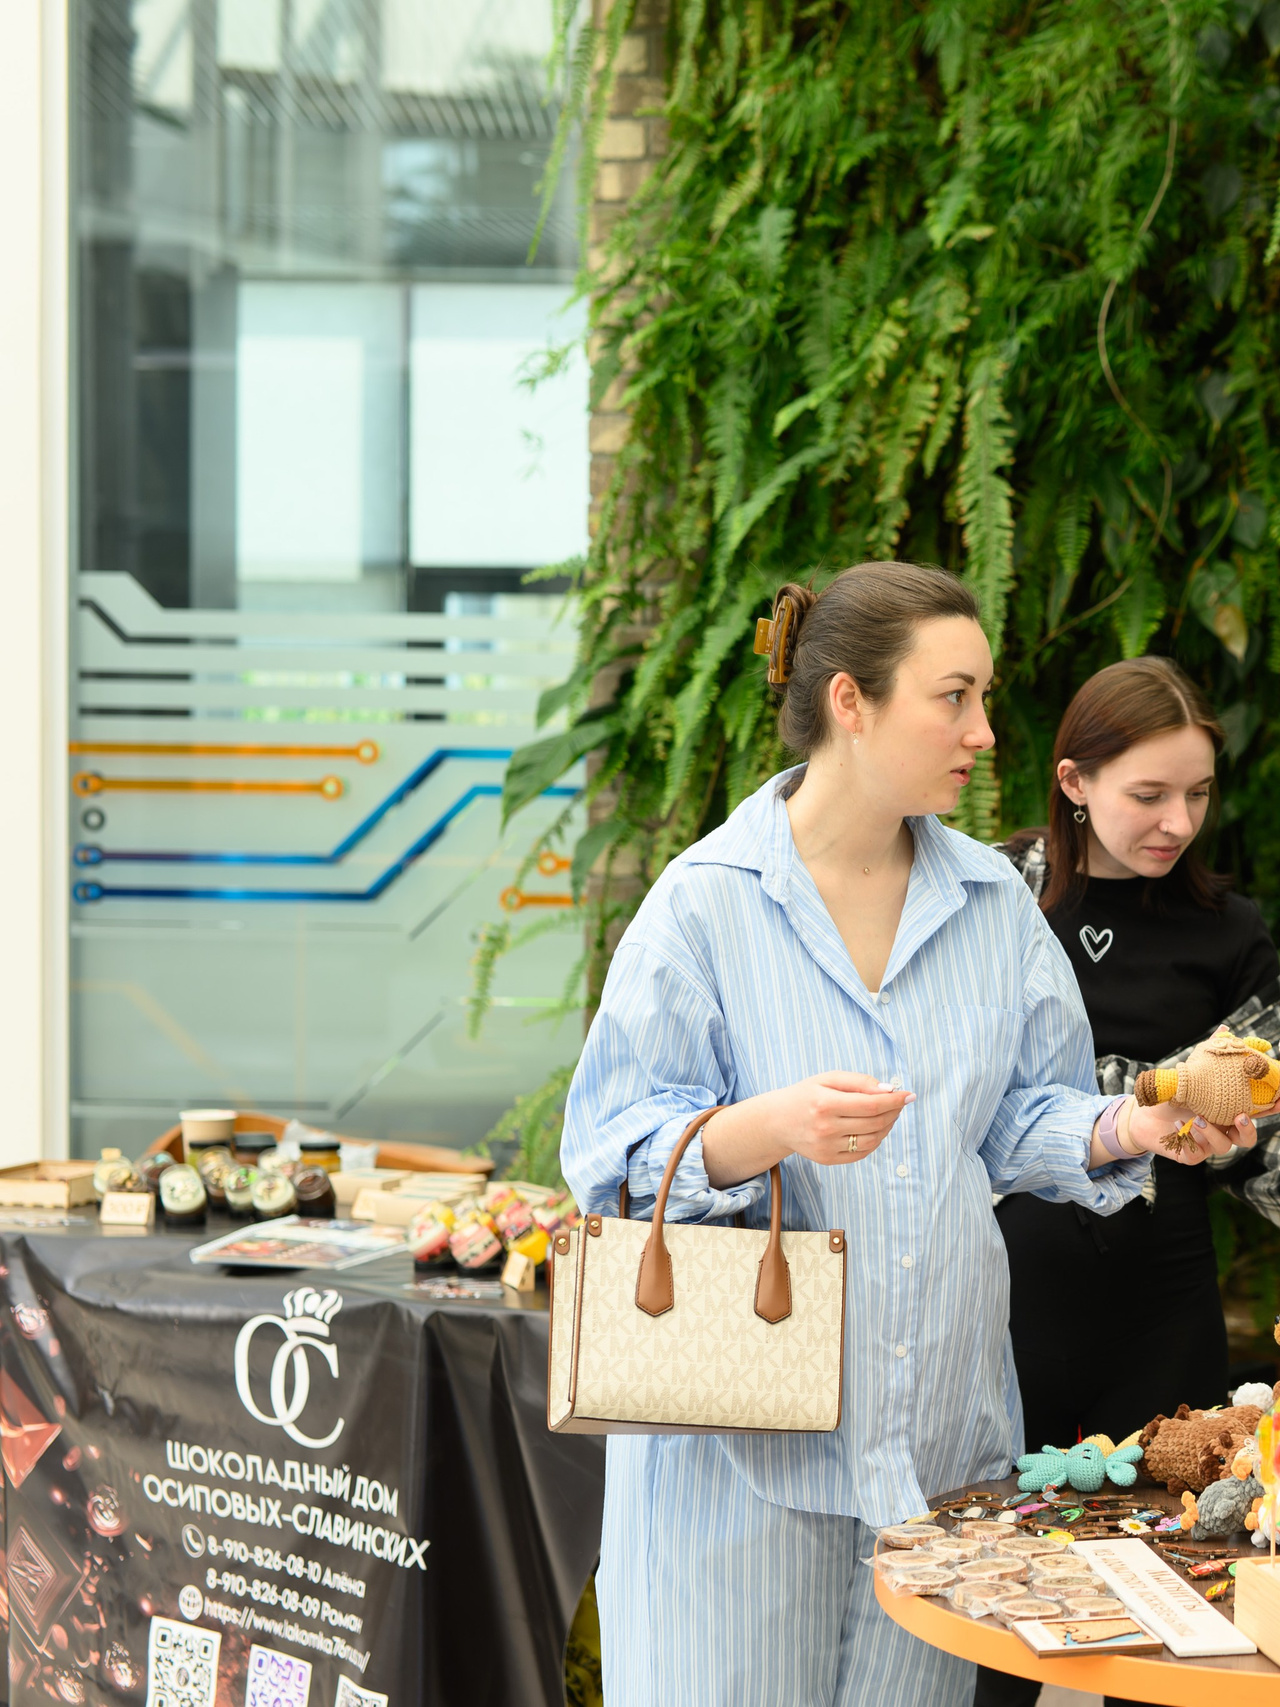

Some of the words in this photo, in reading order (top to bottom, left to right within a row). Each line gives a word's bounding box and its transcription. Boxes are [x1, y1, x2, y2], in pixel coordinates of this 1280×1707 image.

[166, 1440, 351, 1502] ШОКОЛАДНЫЙ
[351, 1475, 399, 1517] ДОМ
[143, 1474, 431, 1571] ОСИПОВЫХ-СЛАВИНСКИХ
[206, 1567, 320, 1618] 8-910-826-08-09
[321, 1601, 364, 1635] Роман
[207, 1535, 322, 1584] 8-910-826-08-10
[322, 1567, 367, 1598] Алёна
